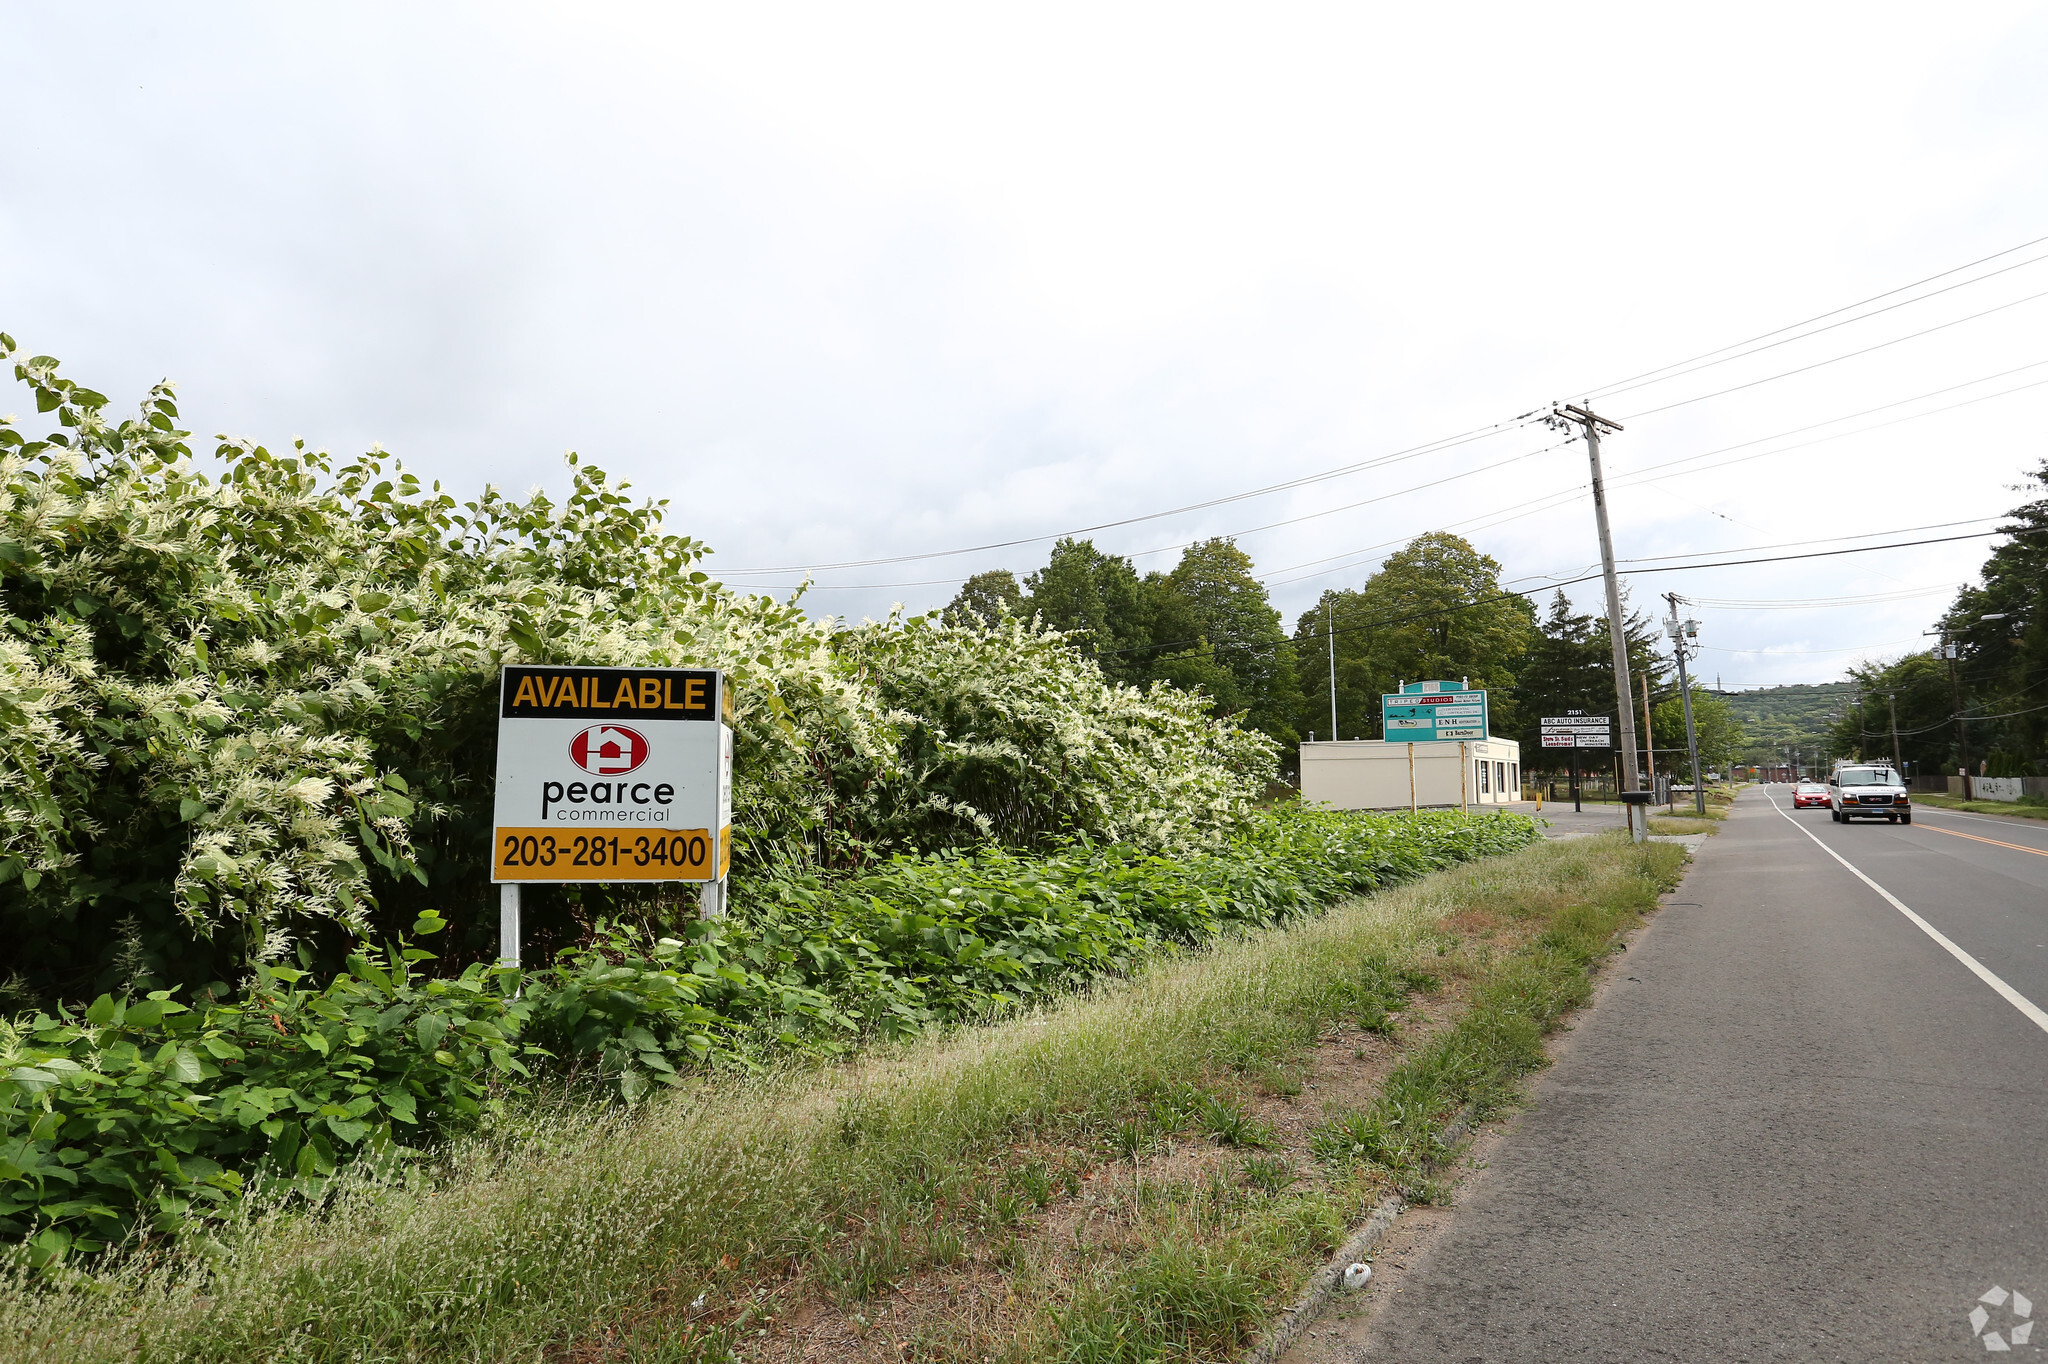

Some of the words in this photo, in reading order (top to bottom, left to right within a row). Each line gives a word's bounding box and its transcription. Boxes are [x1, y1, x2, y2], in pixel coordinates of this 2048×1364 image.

[512, 675, 706, 710] AVAILABLE
[541, 780, 675, 820] pearce
[556, 808, 670, 821] commercial
[502, 835, 706, 867] 203-281-3400
